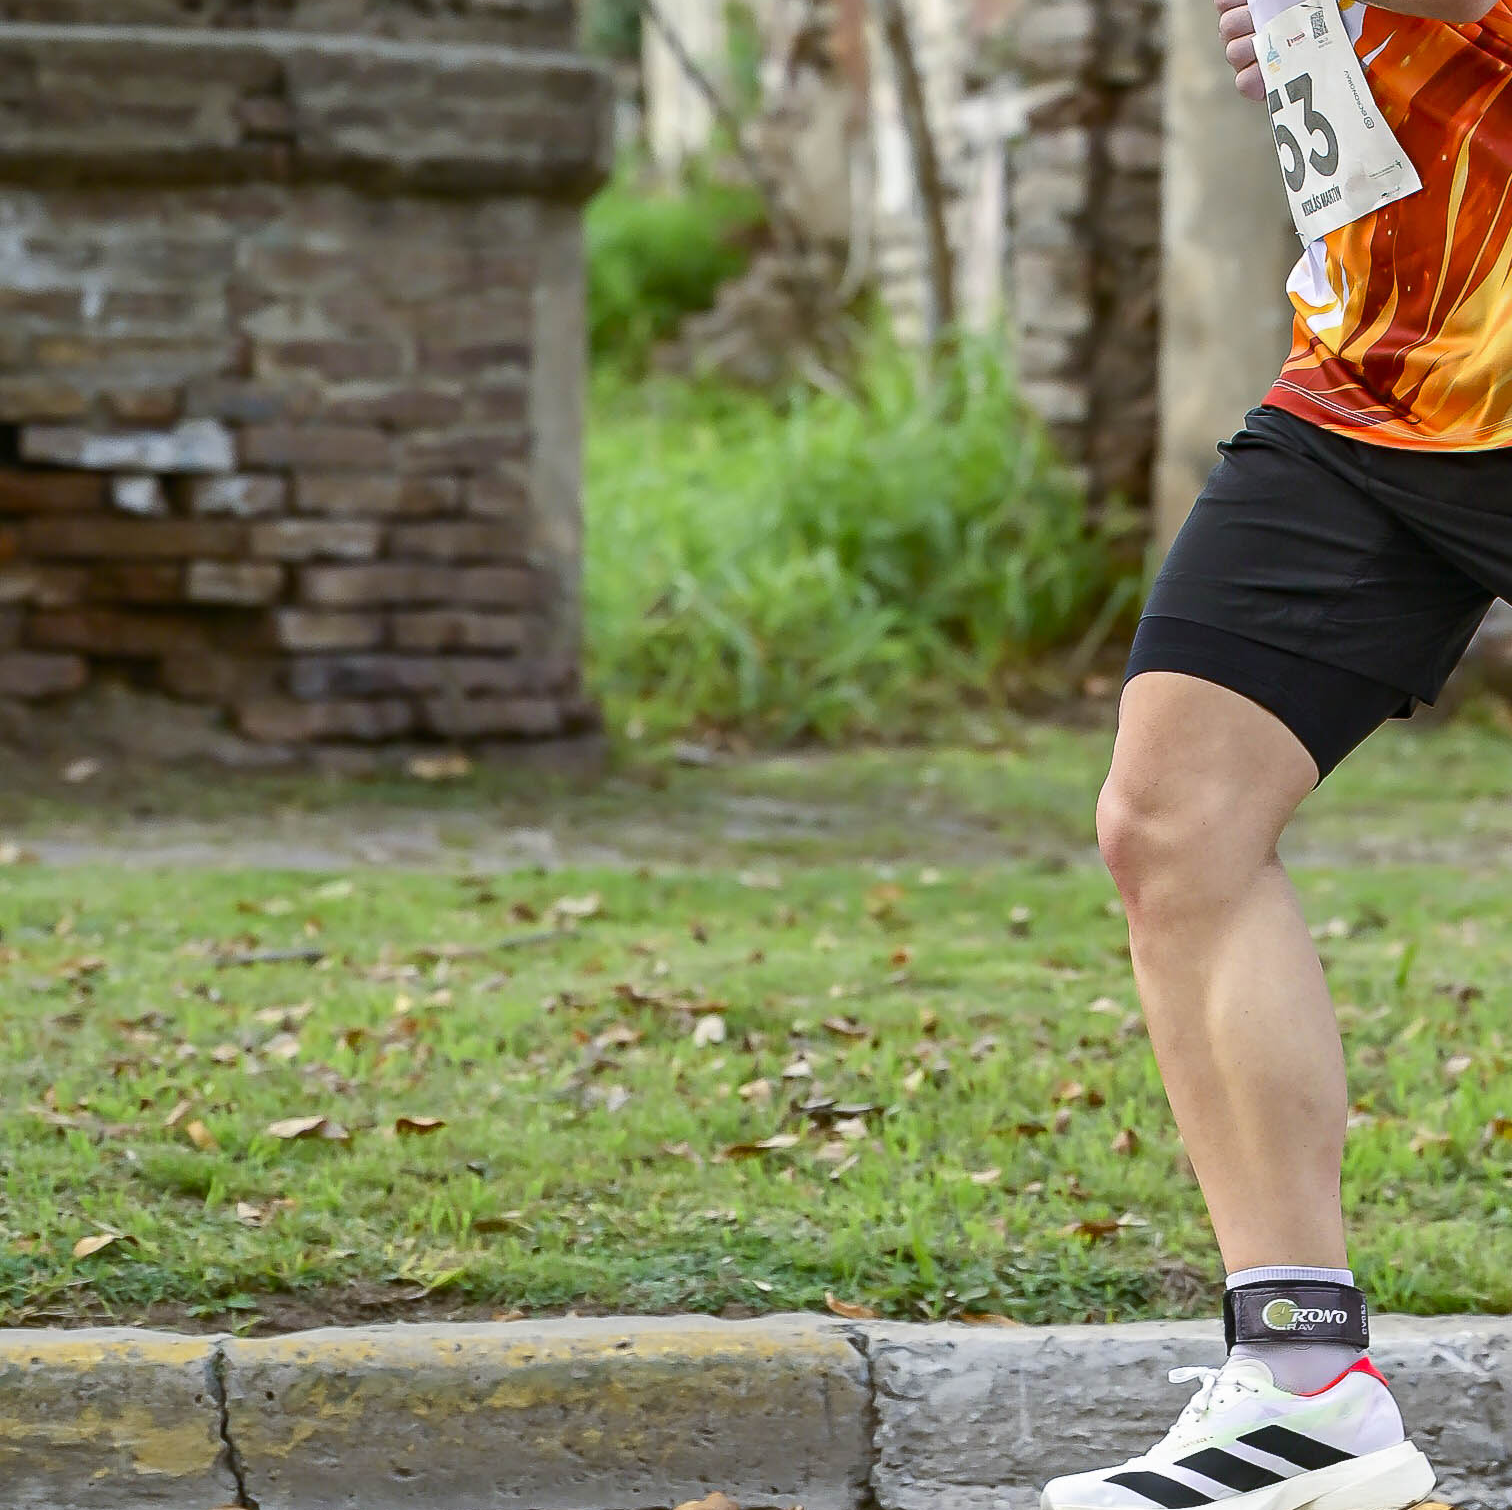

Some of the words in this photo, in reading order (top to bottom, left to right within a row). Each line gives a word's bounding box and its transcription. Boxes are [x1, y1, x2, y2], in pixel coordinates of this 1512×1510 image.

[1267, 72, 1339, 193] 53
[1319, 184, 1342, 208] MARTÍN
[1262, 1298, 1348, 1331] CRONO
